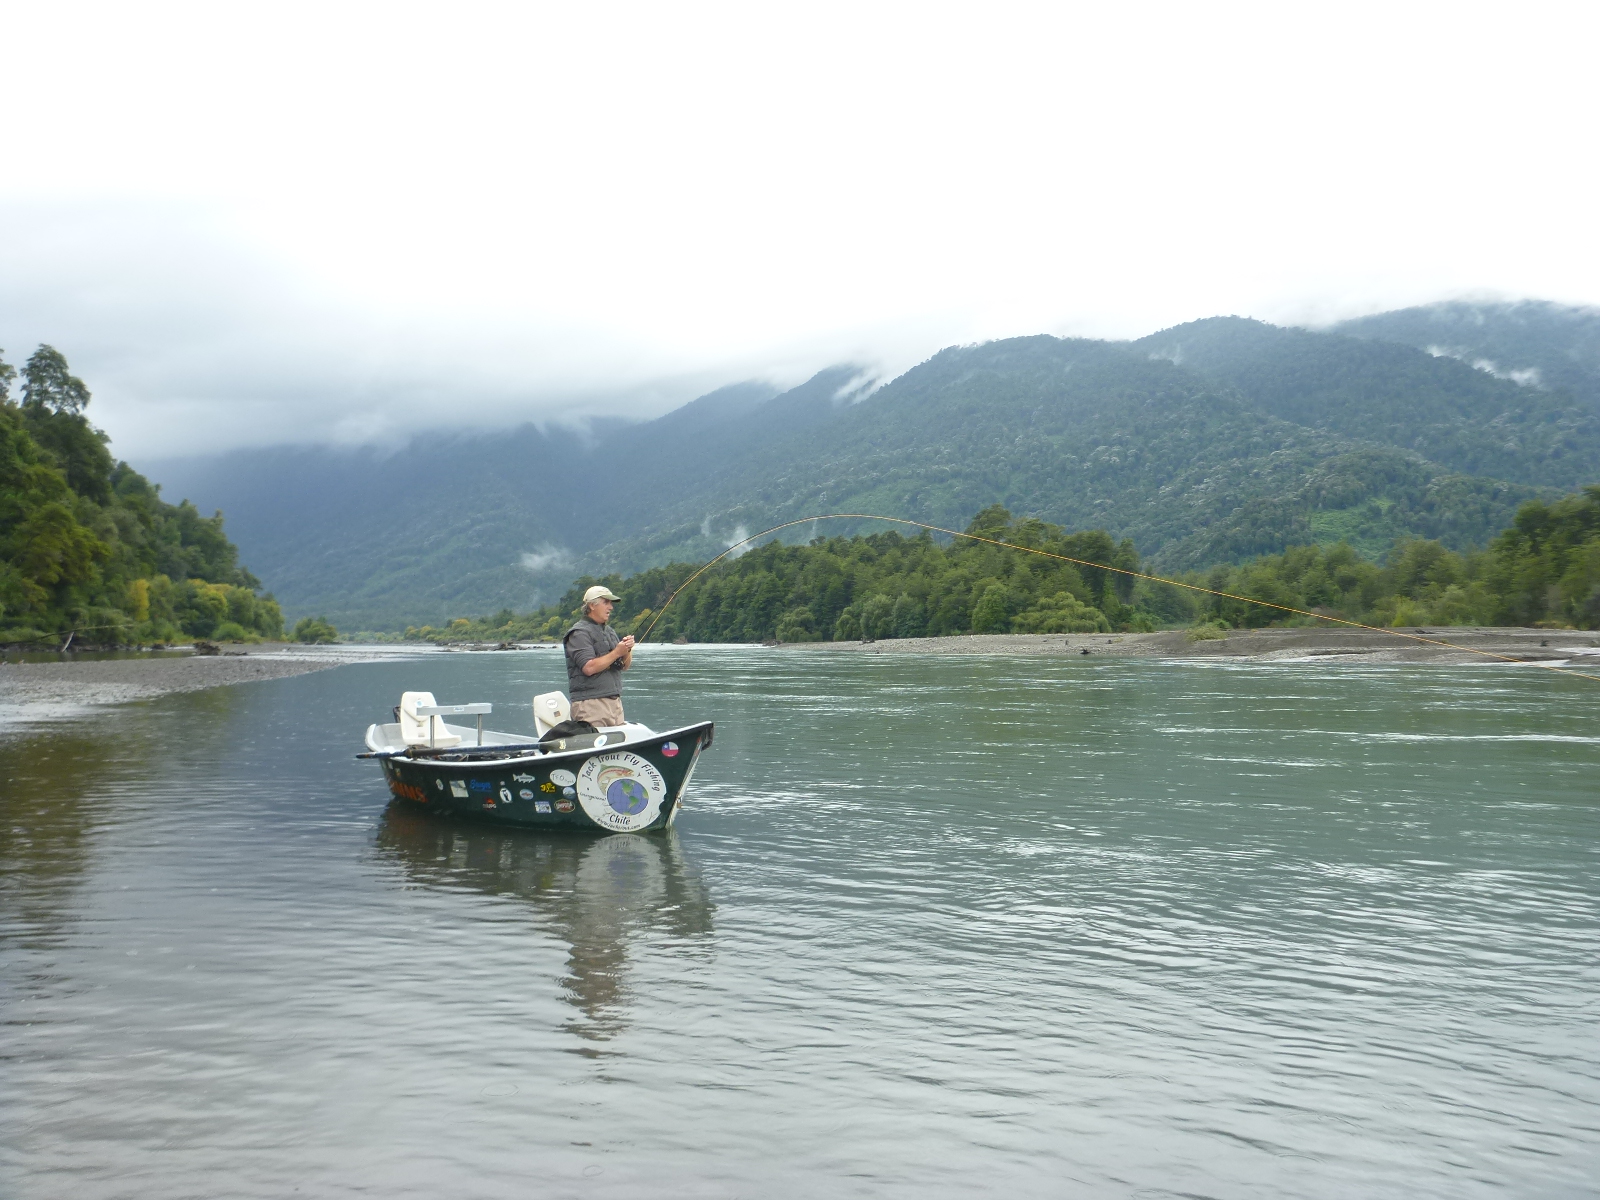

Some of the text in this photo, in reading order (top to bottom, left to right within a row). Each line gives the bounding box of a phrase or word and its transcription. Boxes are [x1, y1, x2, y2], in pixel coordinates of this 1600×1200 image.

[582, 753, 660, 791] Jack Trout Fly Fishing
[609, 814, 631, 825] Chile
